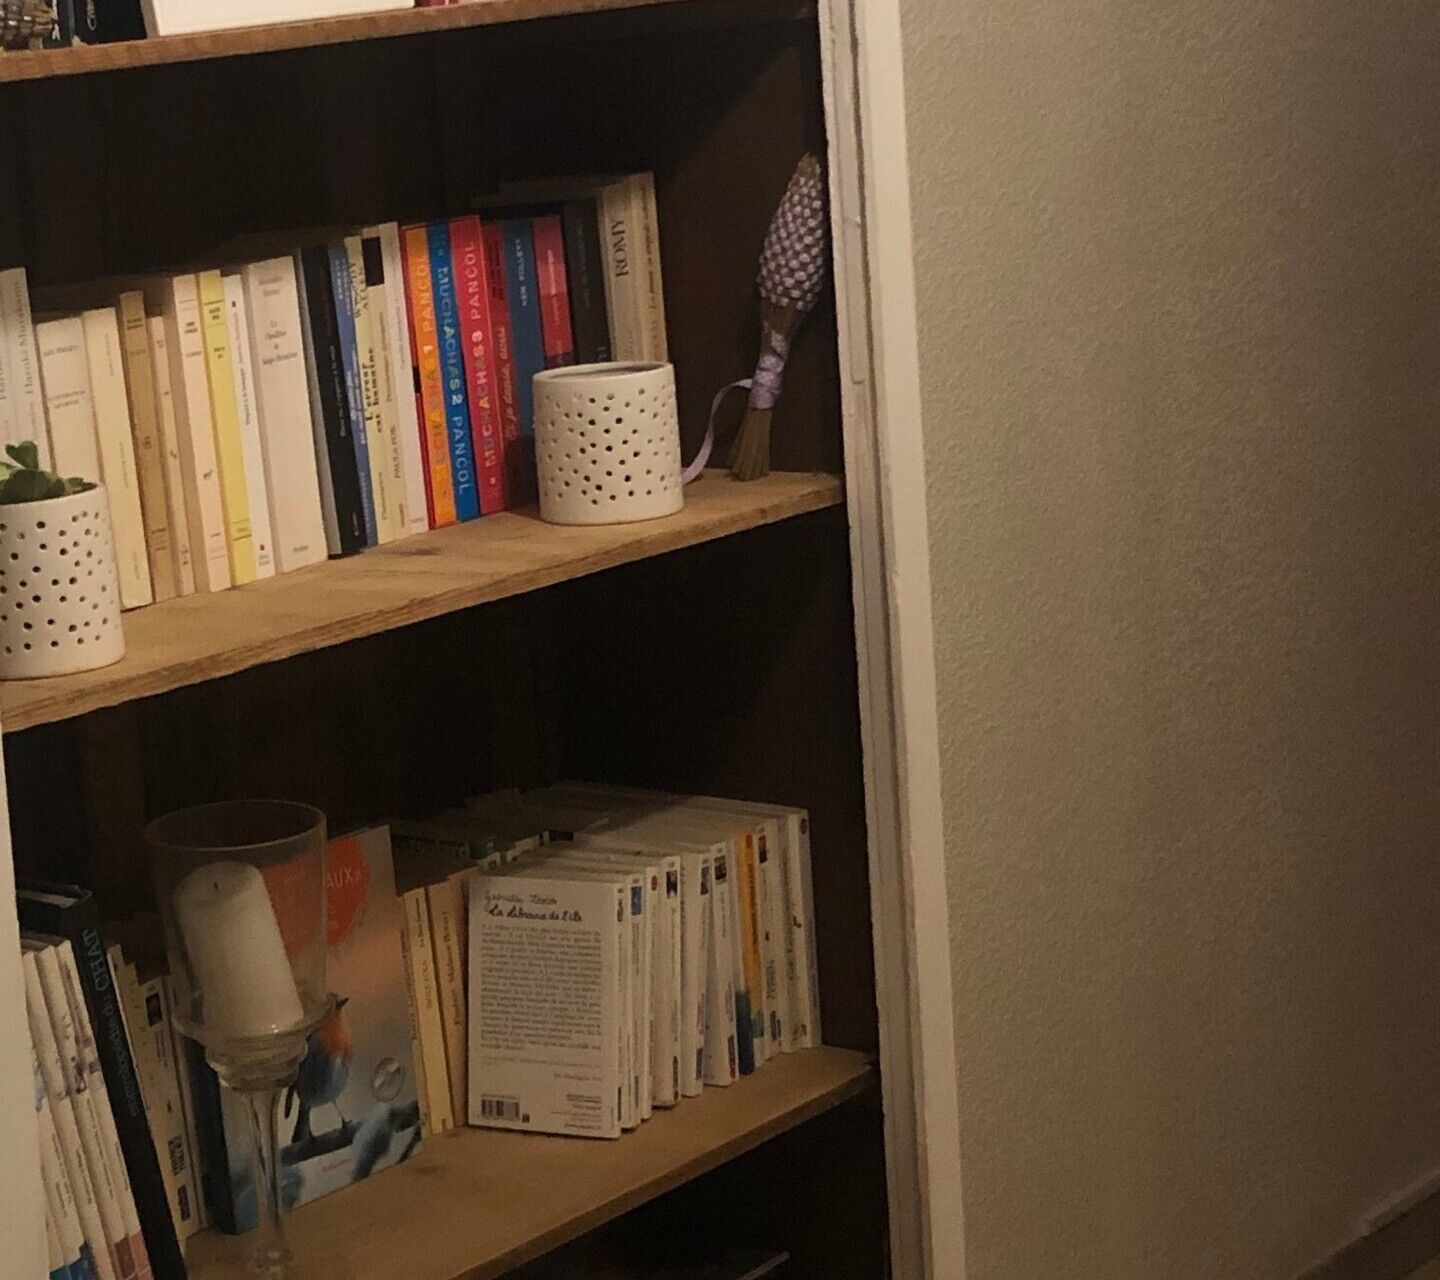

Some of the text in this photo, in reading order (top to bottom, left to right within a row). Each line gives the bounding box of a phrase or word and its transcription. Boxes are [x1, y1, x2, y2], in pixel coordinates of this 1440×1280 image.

[464, 242, 482, 320] PANCOL
[611, 217, 629, 278] ROMY
[416, 257, 434, 332] PANCOL
[20, 351, 34, 395] Haruki
[422, 344, 433, 355] 1
[438, 267, 473, 495] MUCHACHAS 2 PANCOL
[473, 345, 496, 467] MUCHACHAS
[82, 928, 110, 991] CHAT
